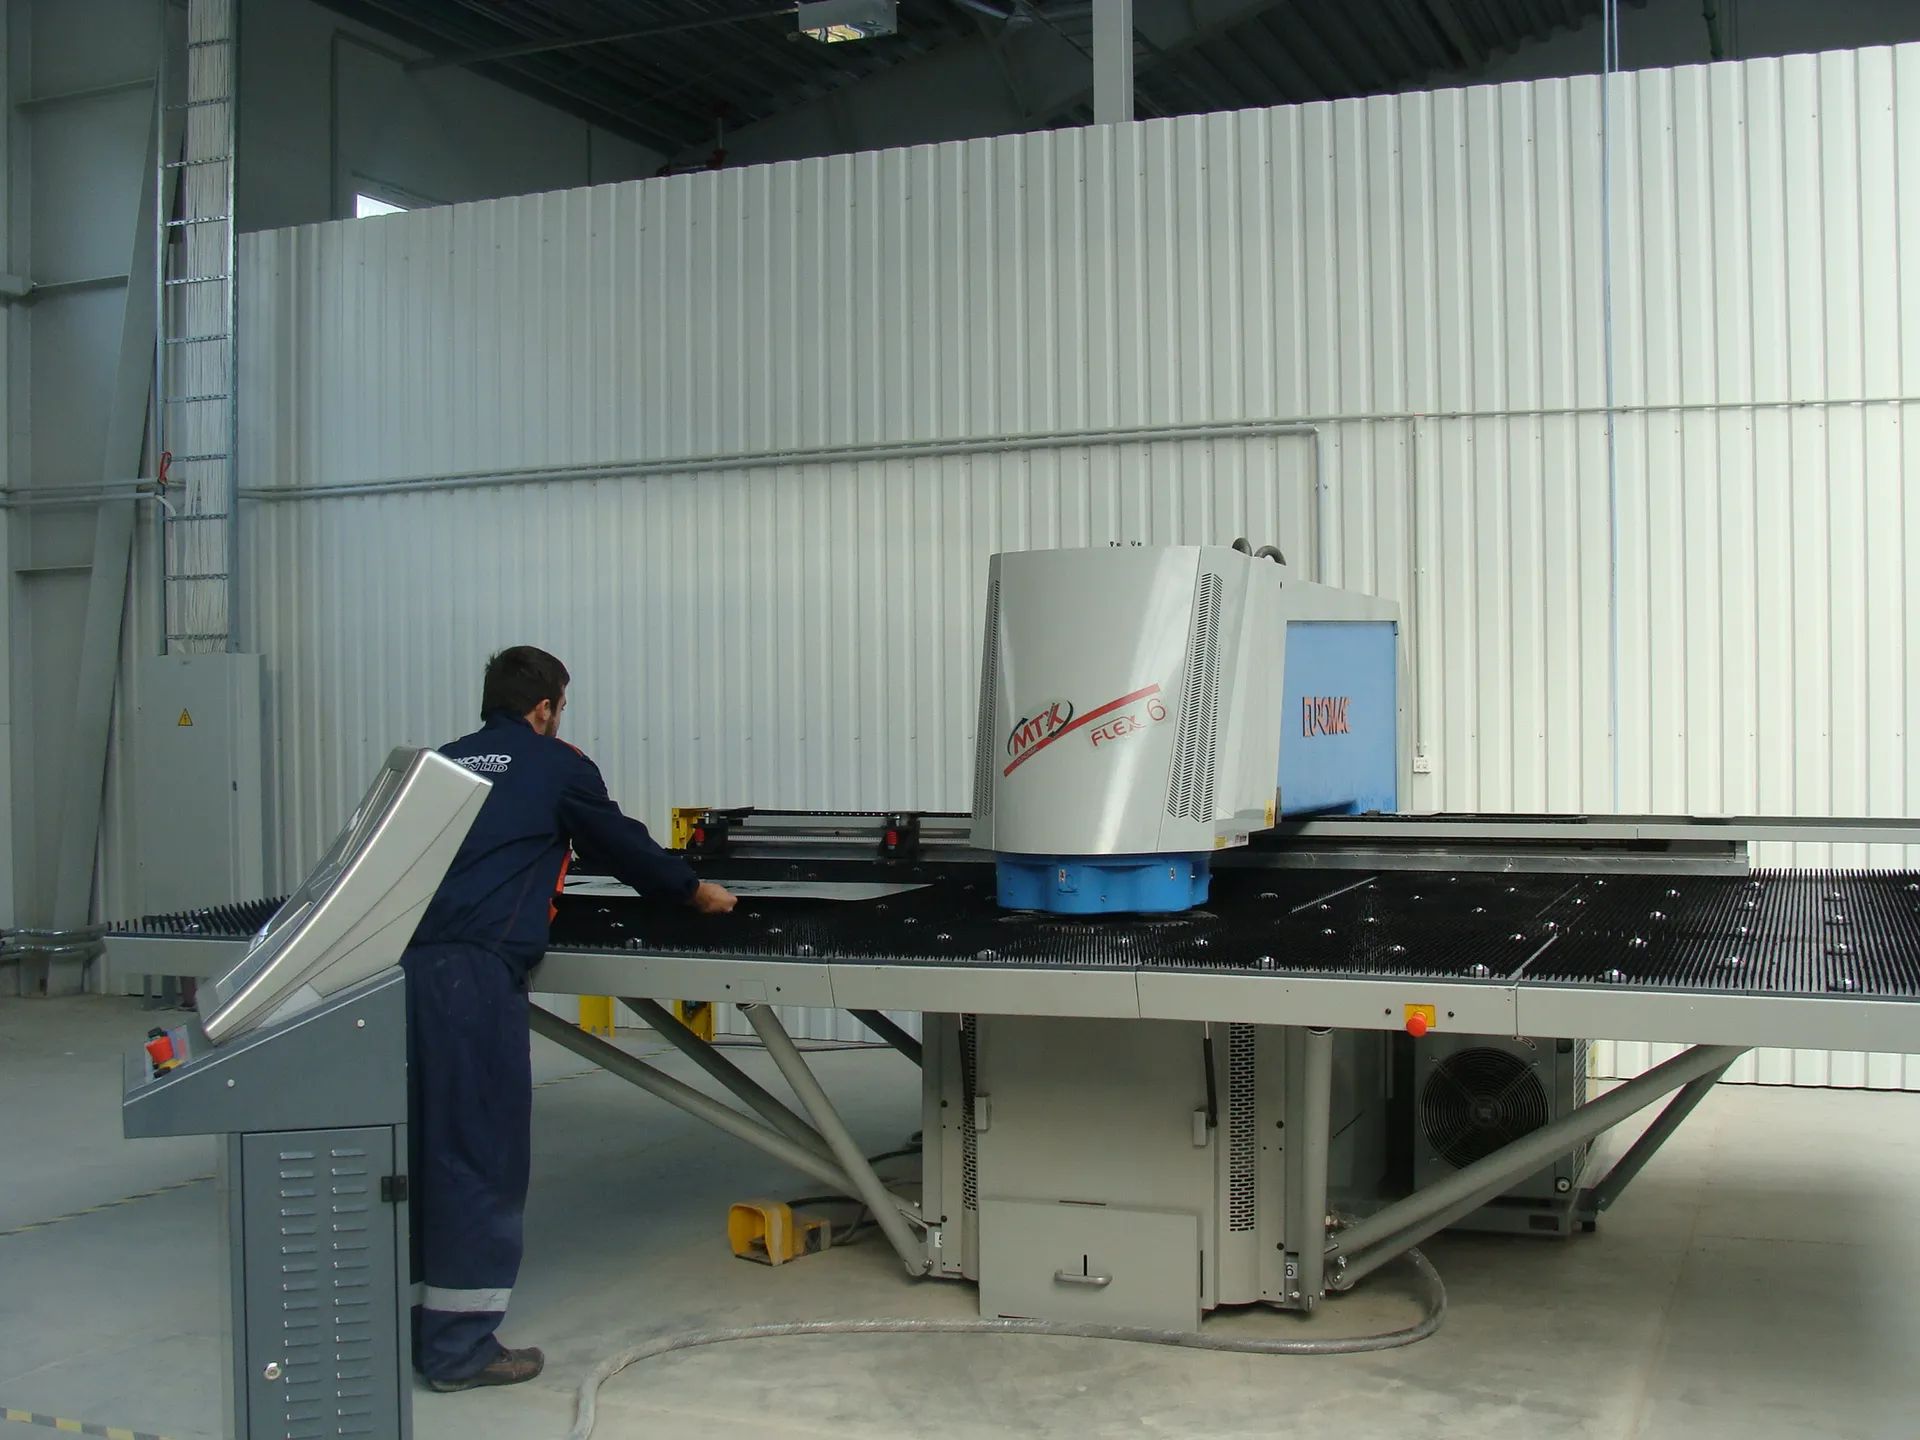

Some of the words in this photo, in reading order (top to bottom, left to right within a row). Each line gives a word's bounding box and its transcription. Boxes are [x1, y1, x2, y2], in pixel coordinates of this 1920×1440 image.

[1013, 702, 1065, 755] MTX
[1091, 715, 1147, 747] FLEX
[1147, 698, 1166, 721] 6
[1302, 696, 1351, 737] EUROMAC
[1286, 1264, 1293, 1276] 6
